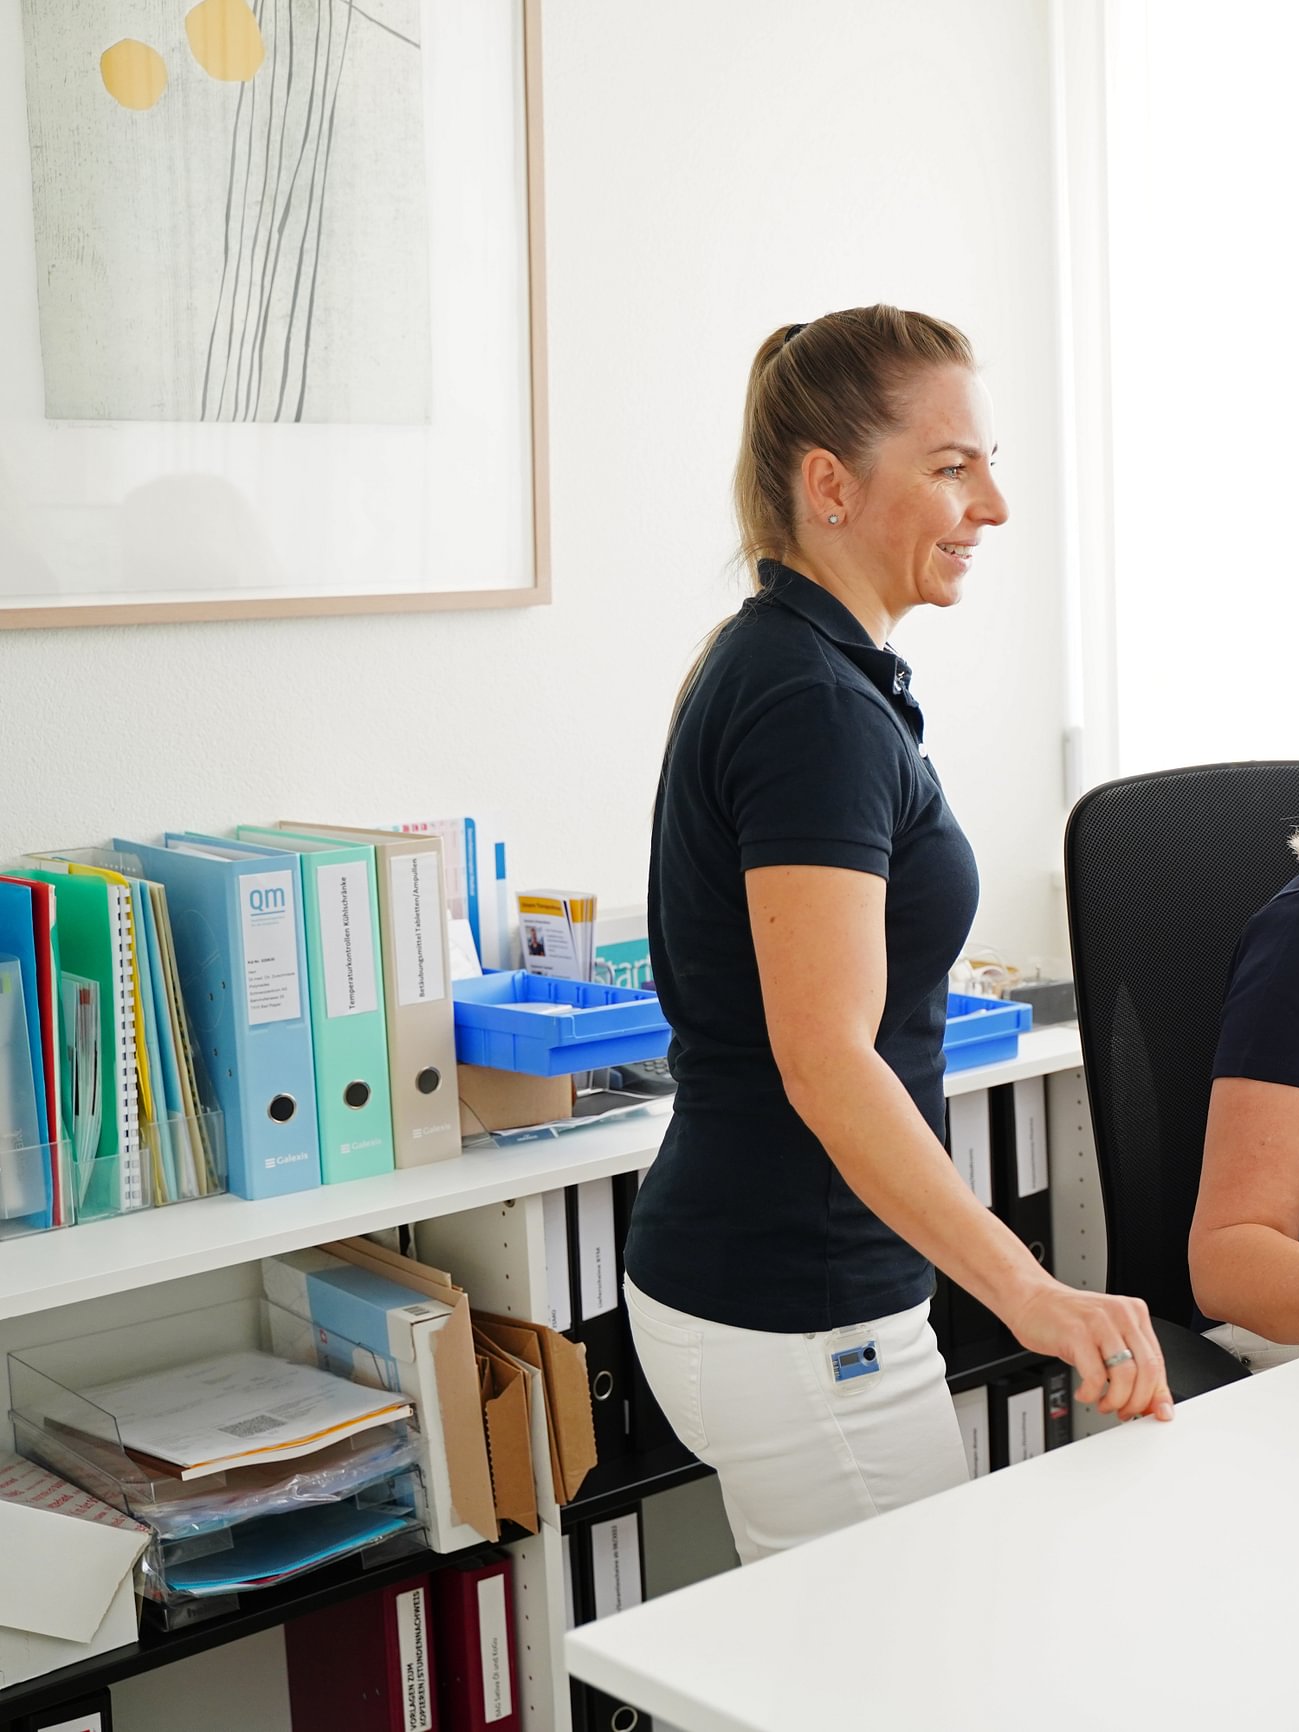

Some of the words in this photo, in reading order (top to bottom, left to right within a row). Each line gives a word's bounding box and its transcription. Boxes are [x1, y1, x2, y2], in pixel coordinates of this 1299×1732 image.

[340, 876, 350, 927] Kühlschränke
[411, 858, 421, 932] Tabletten/Ampullen
[344, 928, 356, 1010] Temperaturkontrollen
[415, 933, 426, 997] Betäubungsmittel
[351, 1137, 383, 1151] Galexis
[422, 1123, 451, 1136] Galexis
[276, 1152, 309, 1165] Galexis
[406, 1662, 415, 1682] ZUM
[412, 1591, 426, 1727] KOPIEREN/STUNDENNACHWEIS
[407, 1684, 418, 1731] VORLAGEN
